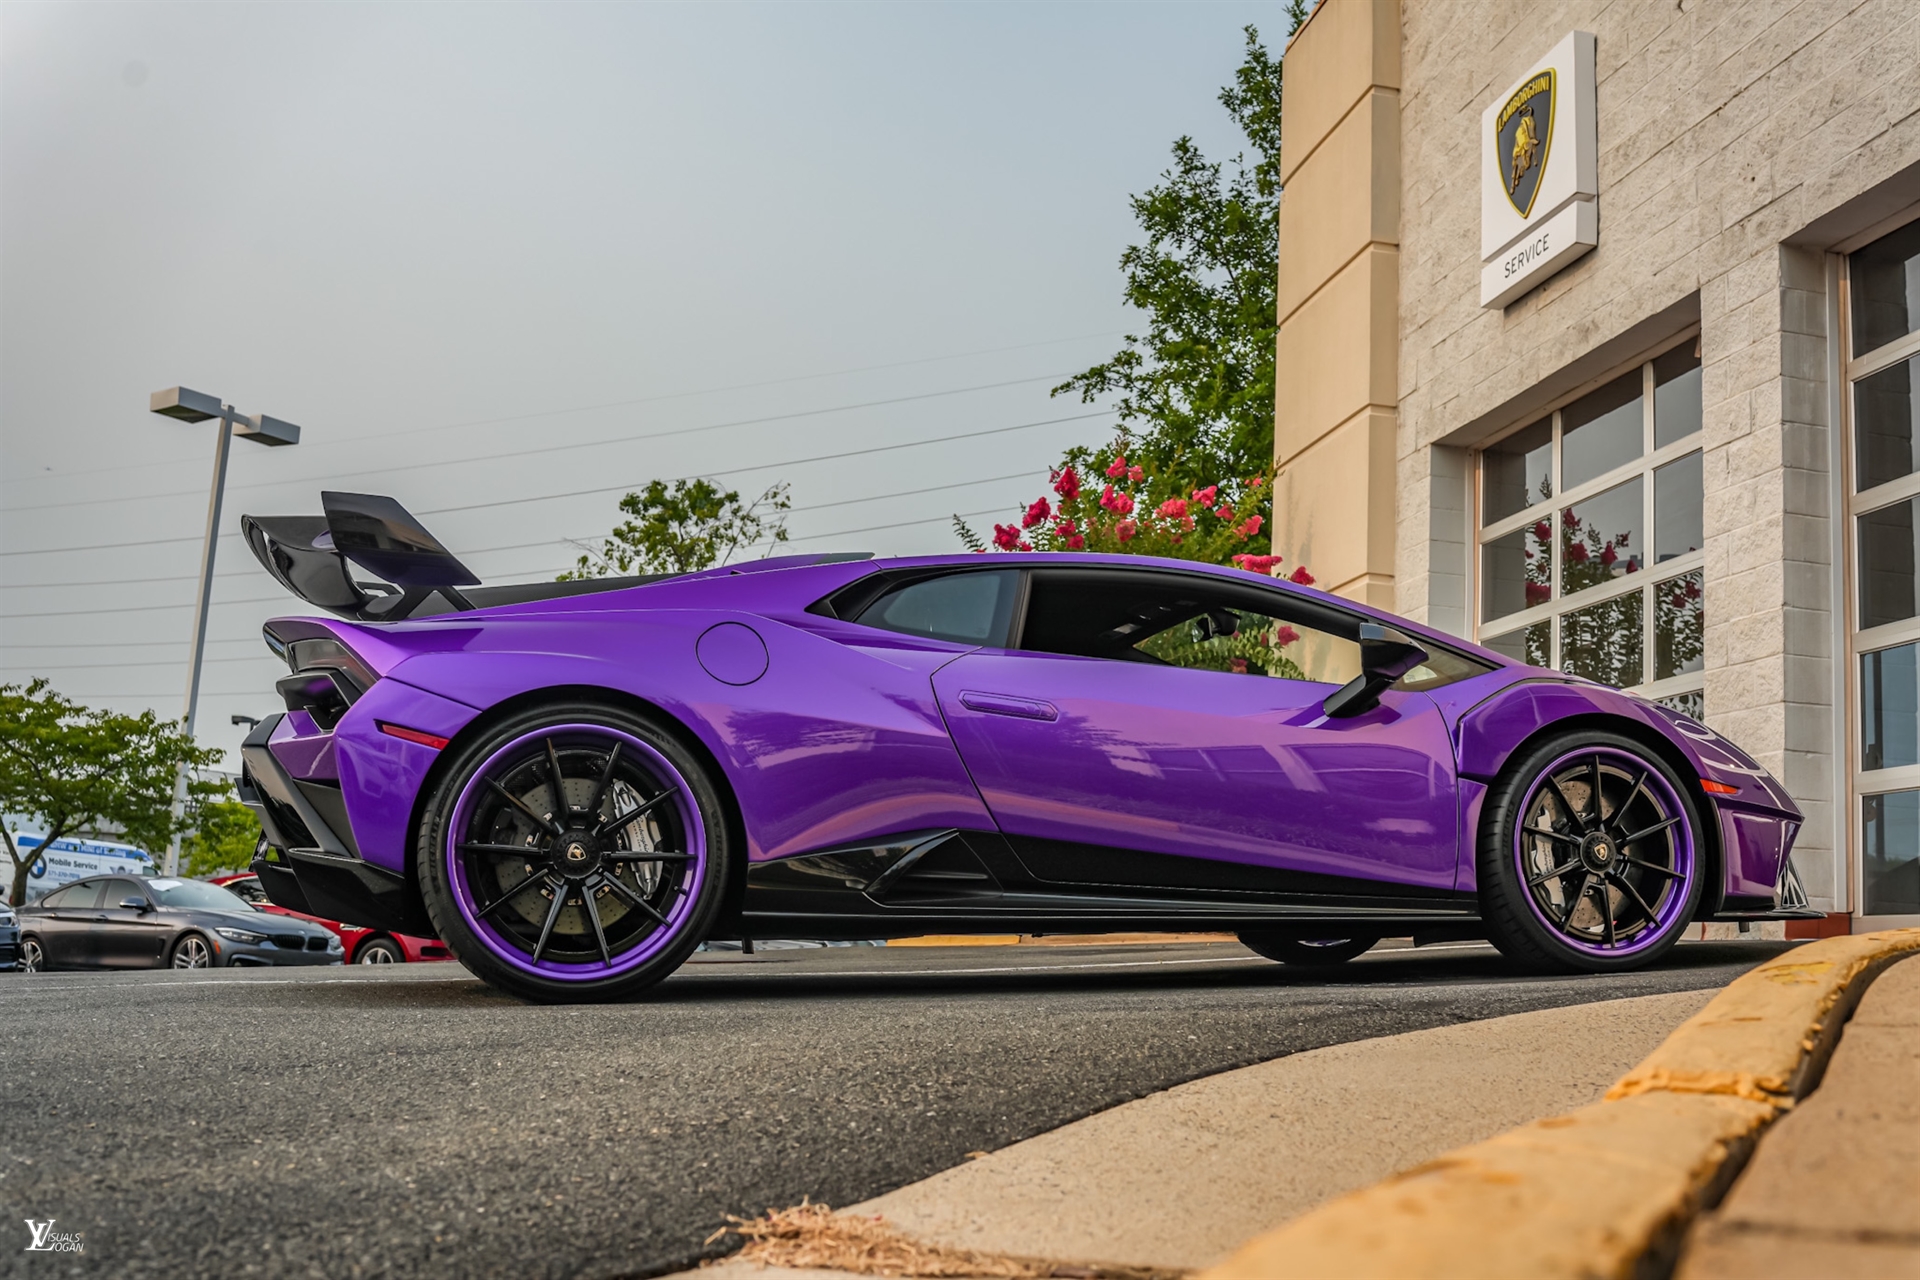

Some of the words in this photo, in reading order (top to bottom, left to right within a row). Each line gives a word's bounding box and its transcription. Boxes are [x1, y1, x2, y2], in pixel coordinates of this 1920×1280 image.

[1498, 76, 1550, 132] LAMBORGHINI
[1504, 233, 1550, 278] SERVICE
[429, 816, 440, 877] MICHELIN
[636, 816, 650, 852] Lamborghin
[48, 857, 71, 867] Mobile
[73, 860, 98, 870] Service
